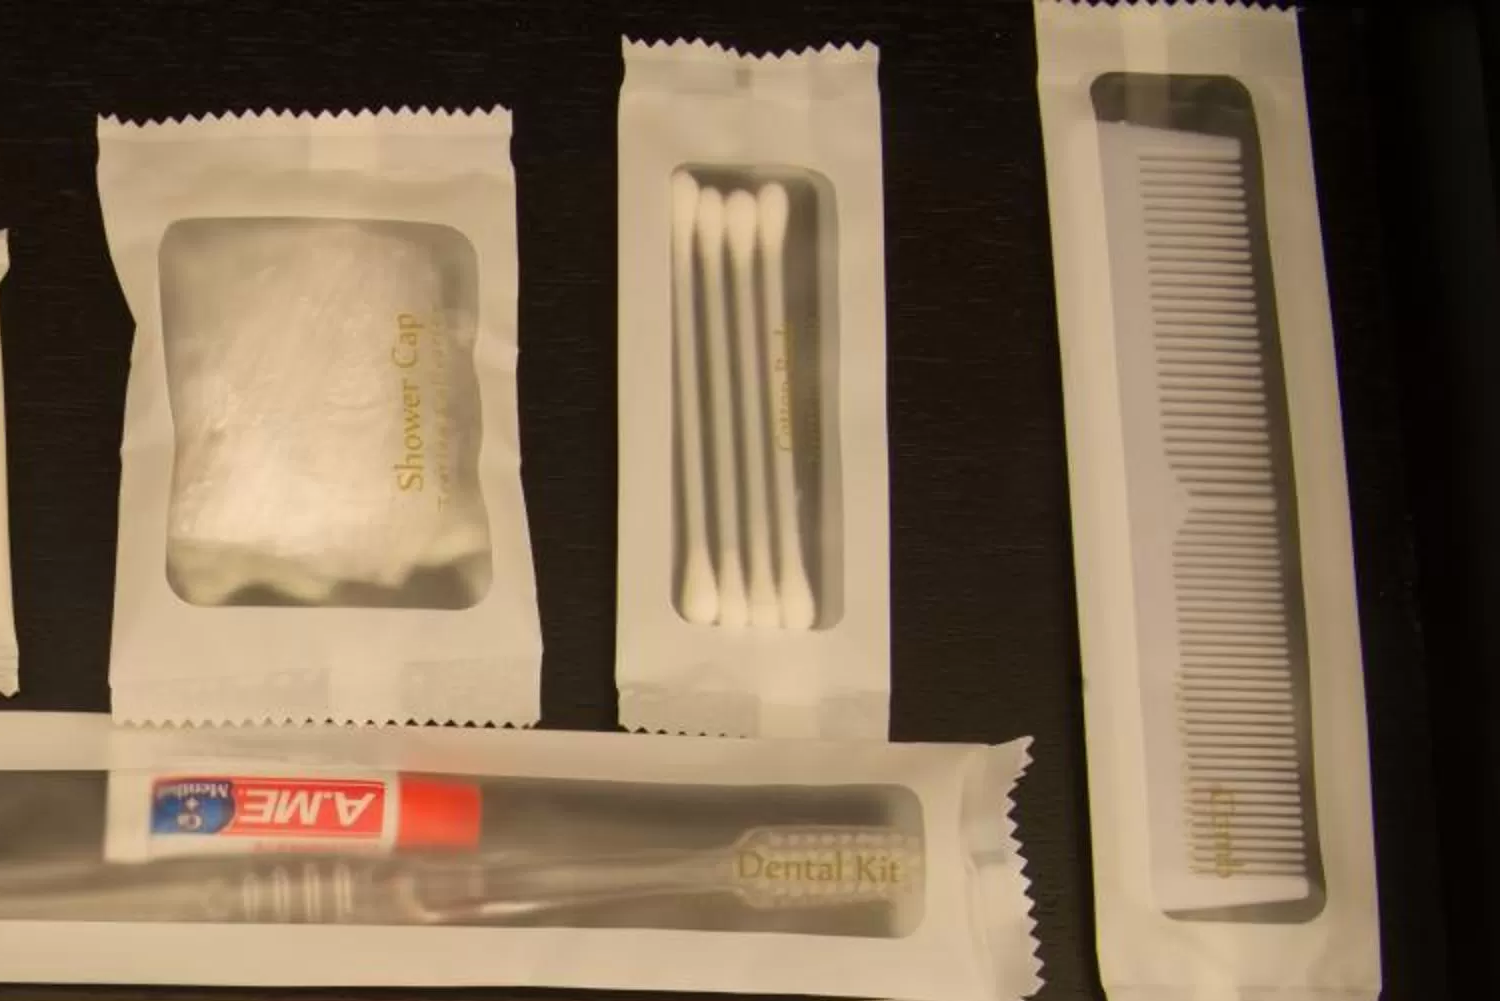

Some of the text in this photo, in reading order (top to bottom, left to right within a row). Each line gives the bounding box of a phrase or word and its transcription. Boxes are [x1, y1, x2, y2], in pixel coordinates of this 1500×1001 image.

[391, 312, 425, 493] Shower Cap
[177, 813, 202, 831] Ca
[737, 850, 902, 884] Dental Kit
